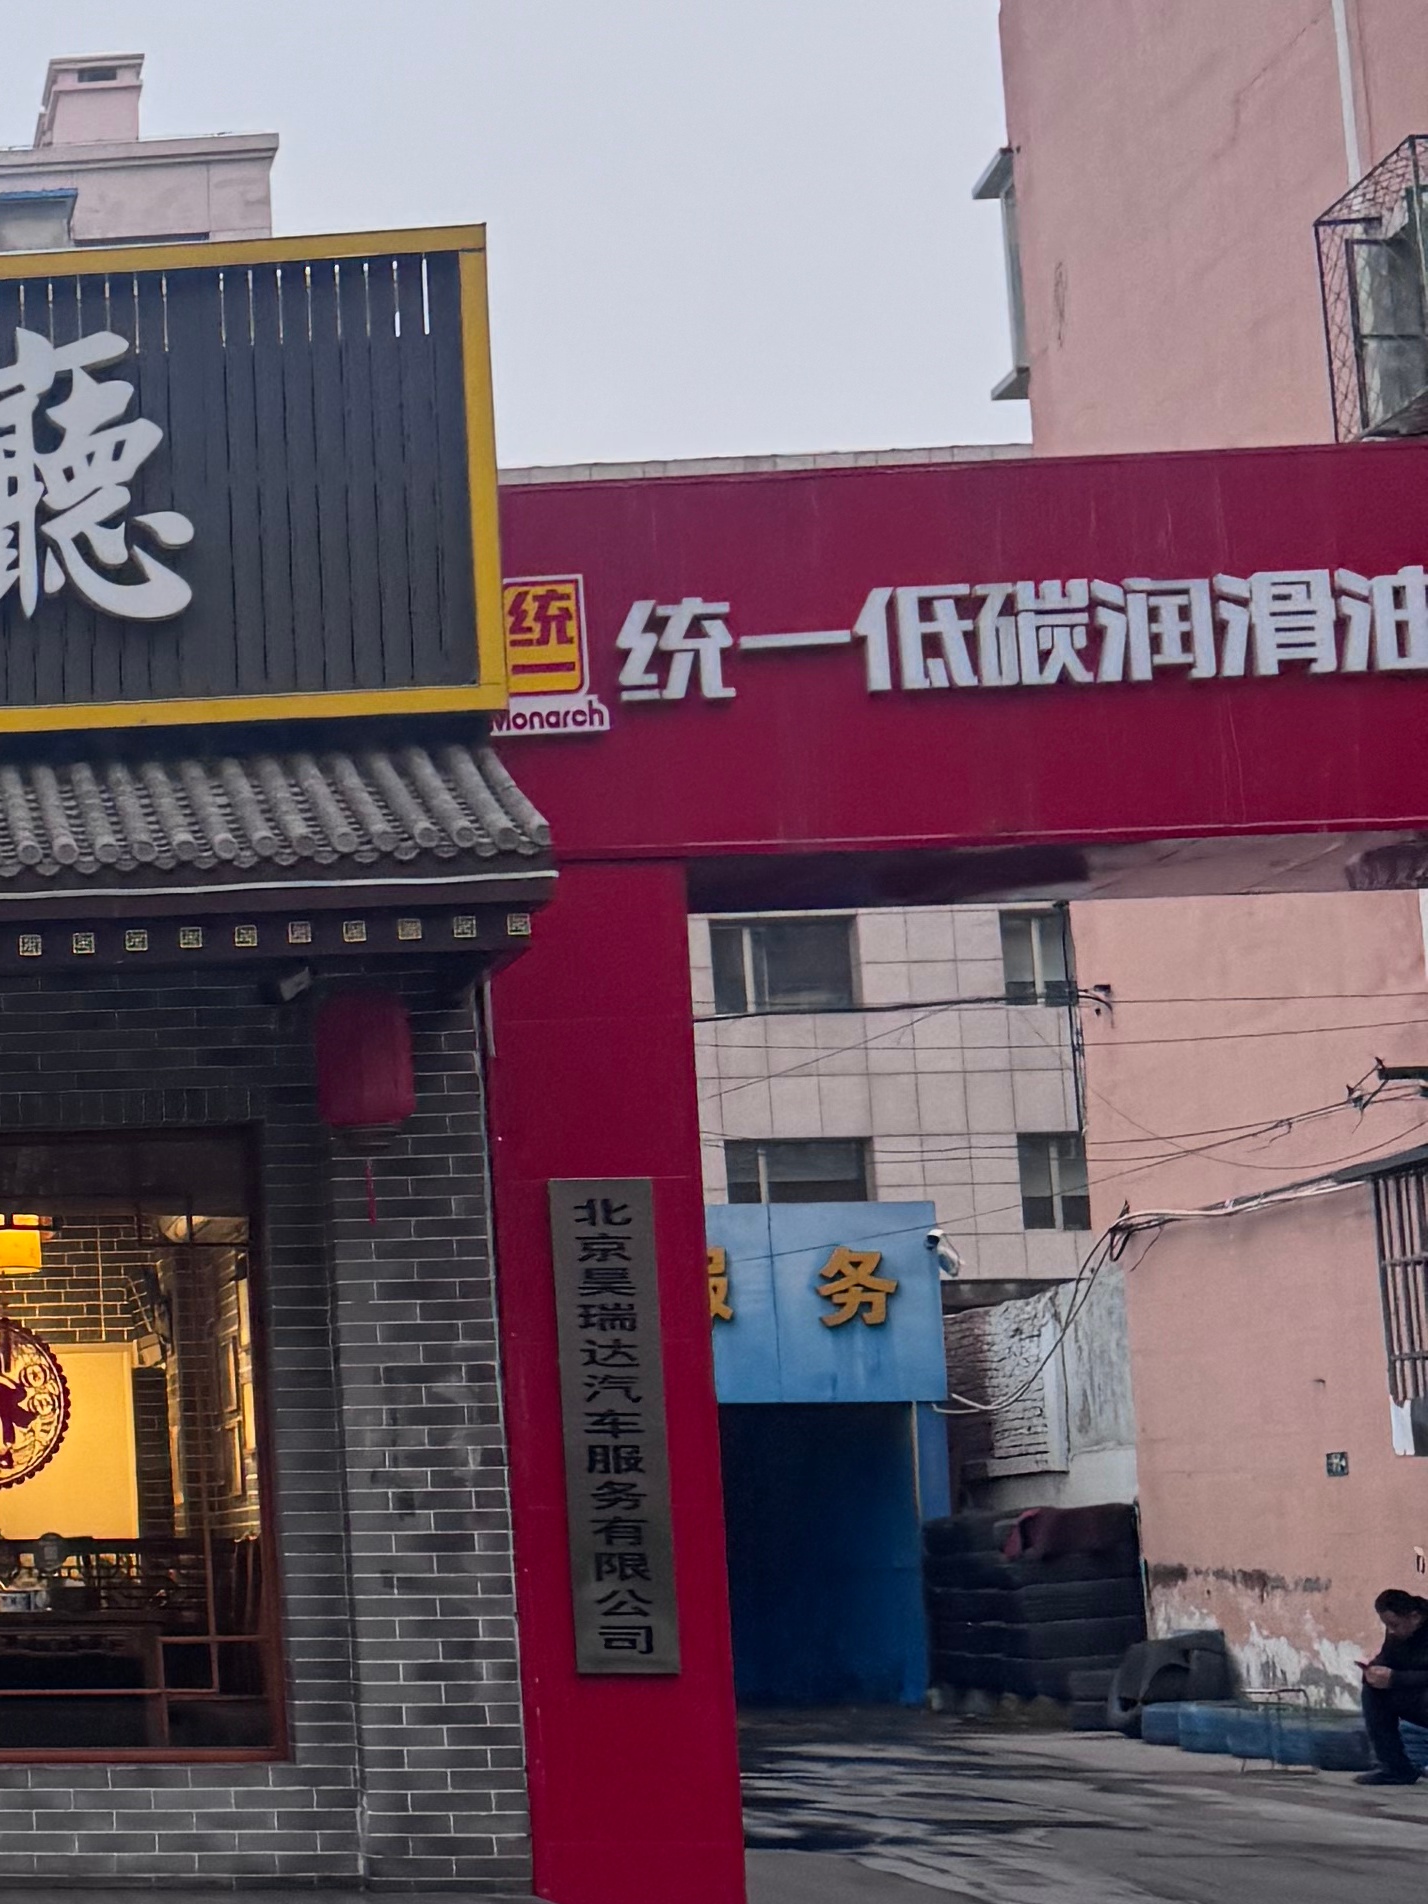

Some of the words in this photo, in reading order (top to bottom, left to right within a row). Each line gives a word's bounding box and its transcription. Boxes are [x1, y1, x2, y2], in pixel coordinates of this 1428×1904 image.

[574, 1198, 655, 1654] 北京昊瑞达汽车服务有限公司
